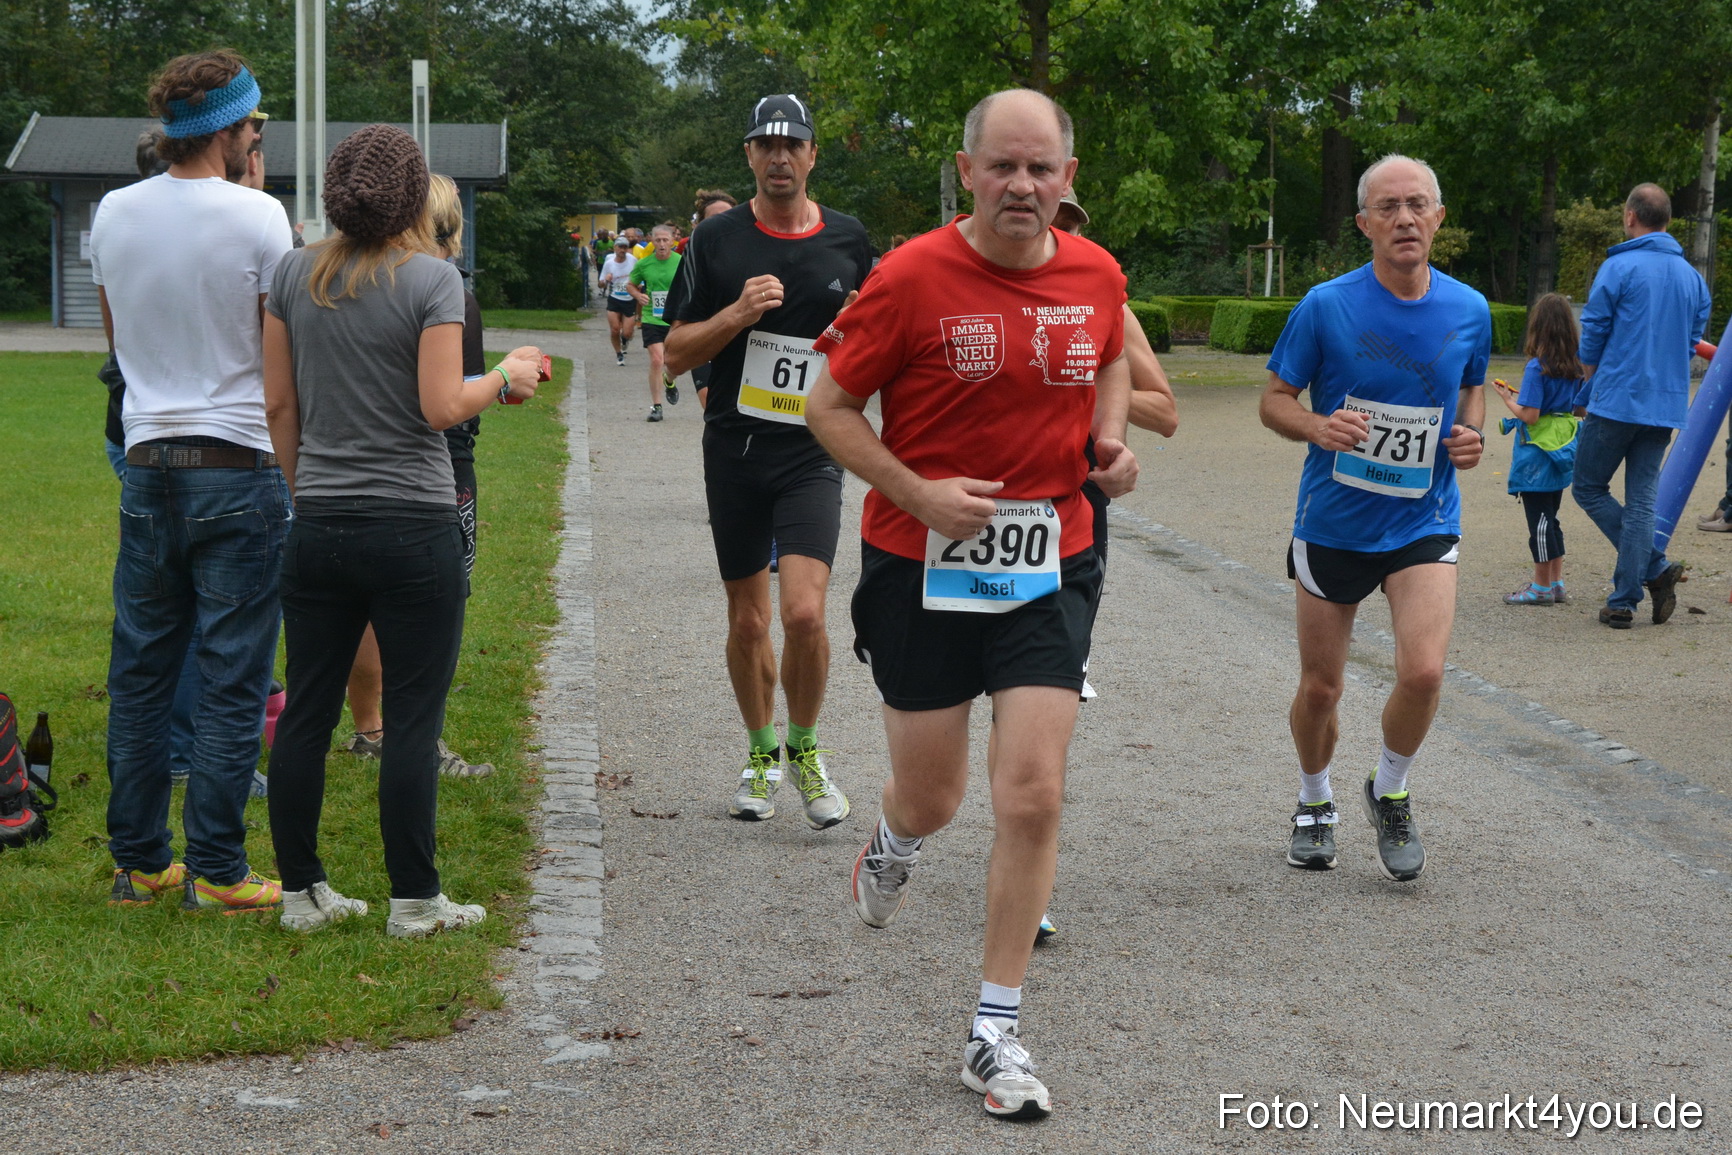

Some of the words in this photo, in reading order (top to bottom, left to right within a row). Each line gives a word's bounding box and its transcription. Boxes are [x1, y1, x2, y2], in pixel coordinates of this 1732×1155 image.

[1021, 307, 1036, 316] 11.
[1036, 305, 1095, 316] NEUMARKTER
[1036, 315, 1086, 325] STADTLAUF
[951, 323, 995, 336] IMMER
[749, 338, 781, 352] PARTL
[950, 334, 998, 346] WIEDER
[955, 345, 995, 361] NEU
[955, 361, 996, 372] MARKT
[772, 357, 809, 391] 61
[771, 396, 801, 412] Willi
[1381, 412, 1426, 425] Neumarkt
[1365, 465, 1404, 484] Heinz
[969, 577, 1015, 596] Josef
